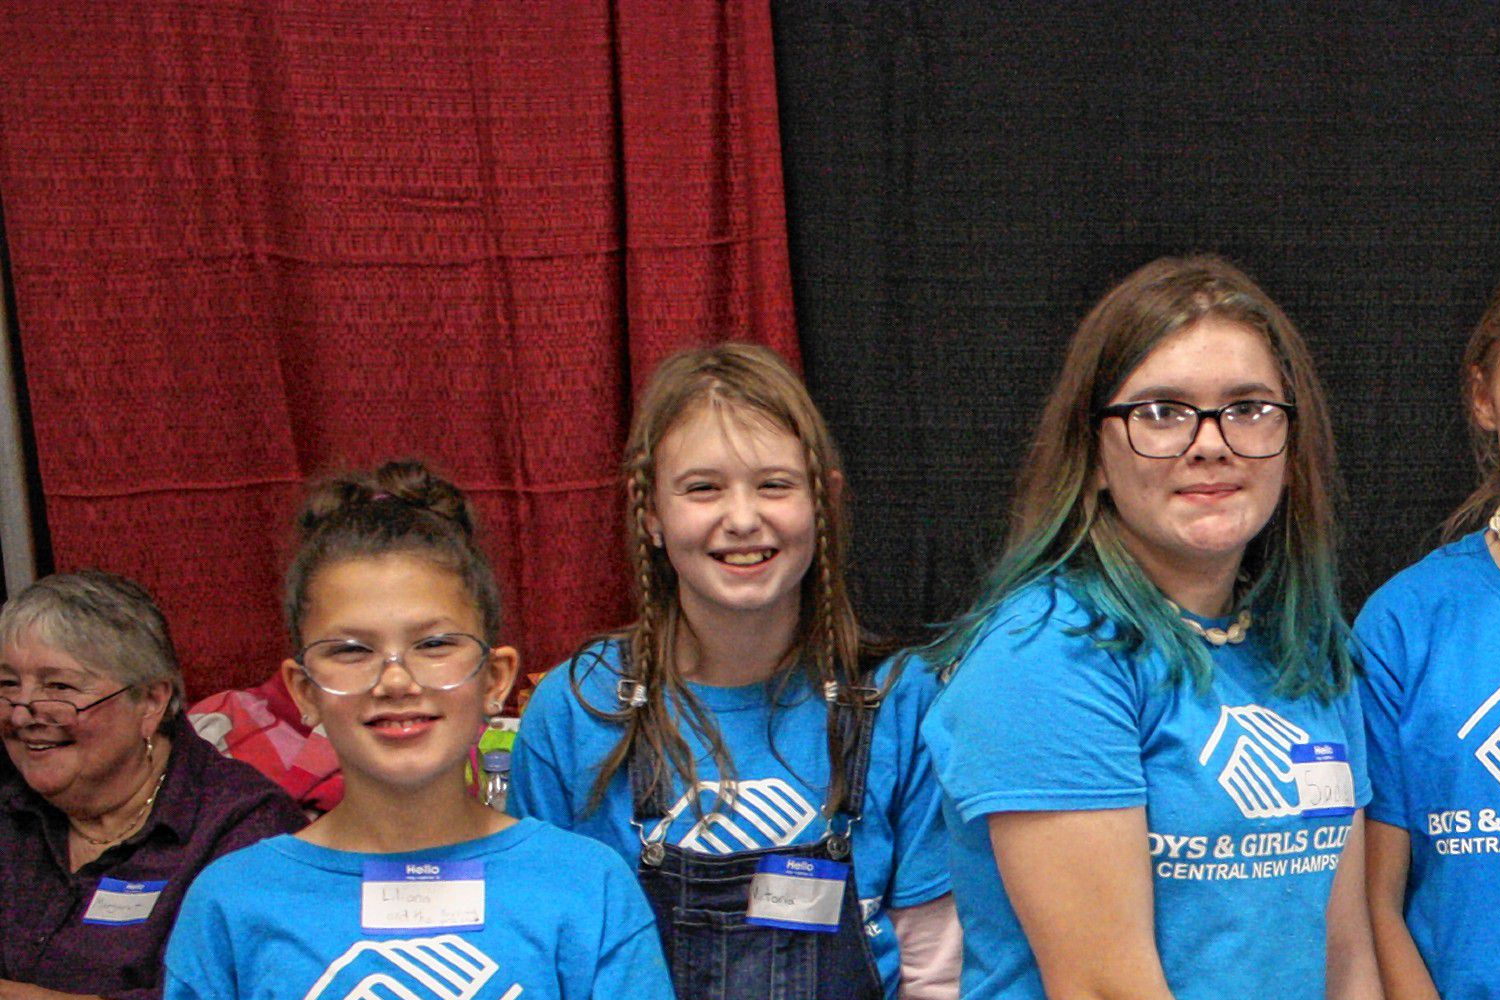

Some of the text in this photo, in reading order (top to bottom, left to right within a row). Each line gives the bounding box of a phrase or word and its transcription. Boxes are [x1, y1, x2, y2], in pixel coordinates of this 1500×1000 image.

[1147, 832, 1208, 859] OYS
[1213, 834, 1235, 859] &
[1240, 829, 1309, 857] GIRLS
[1157, 853, 1339, 881] CENTRAL NEW HAMPS
